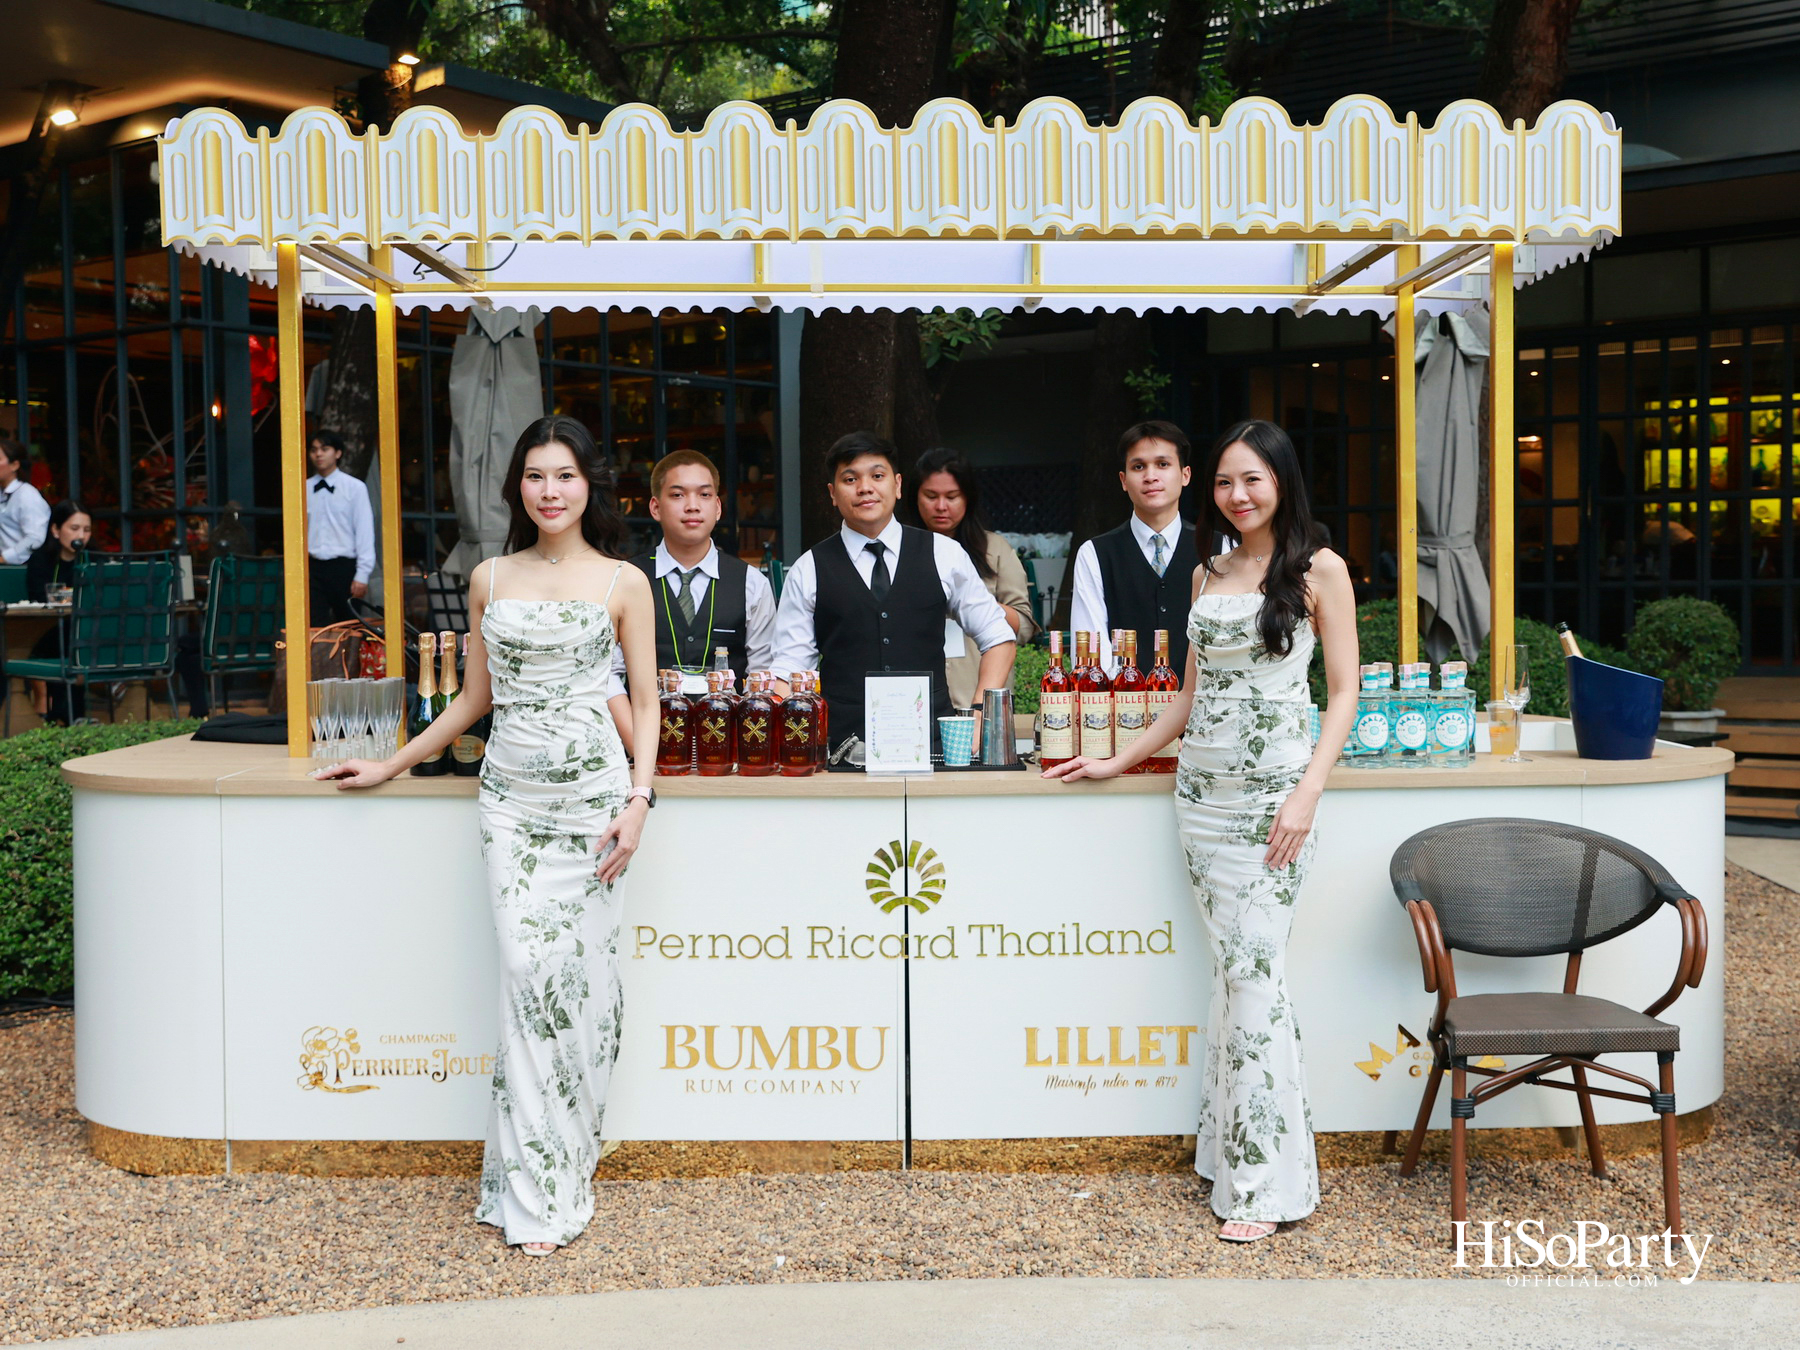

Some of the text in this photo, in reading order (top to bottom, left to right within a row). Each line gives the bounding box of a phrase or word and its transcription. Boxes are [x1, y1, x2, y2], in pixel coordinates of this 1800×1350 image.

[1041, 695, 1071, 704] LILLET
[1361, 715, 1386, 727] MALFY
[1399, 715, 1425, 726] MALFY
[1439, 714, 1465, 726] MALFY
[632, 920, 1175, 960] Pernod Ricard Thailand
[379, 1032, 457, 1044] CHAMPAGNE
[659, 1024, 891, 1072] BUMBU
[1024, 1025, 1199, 1067] LILLET
[685, 1078, 862, 1094] RUM COMPANY
[1135, 1077, 1148, 1088] en
